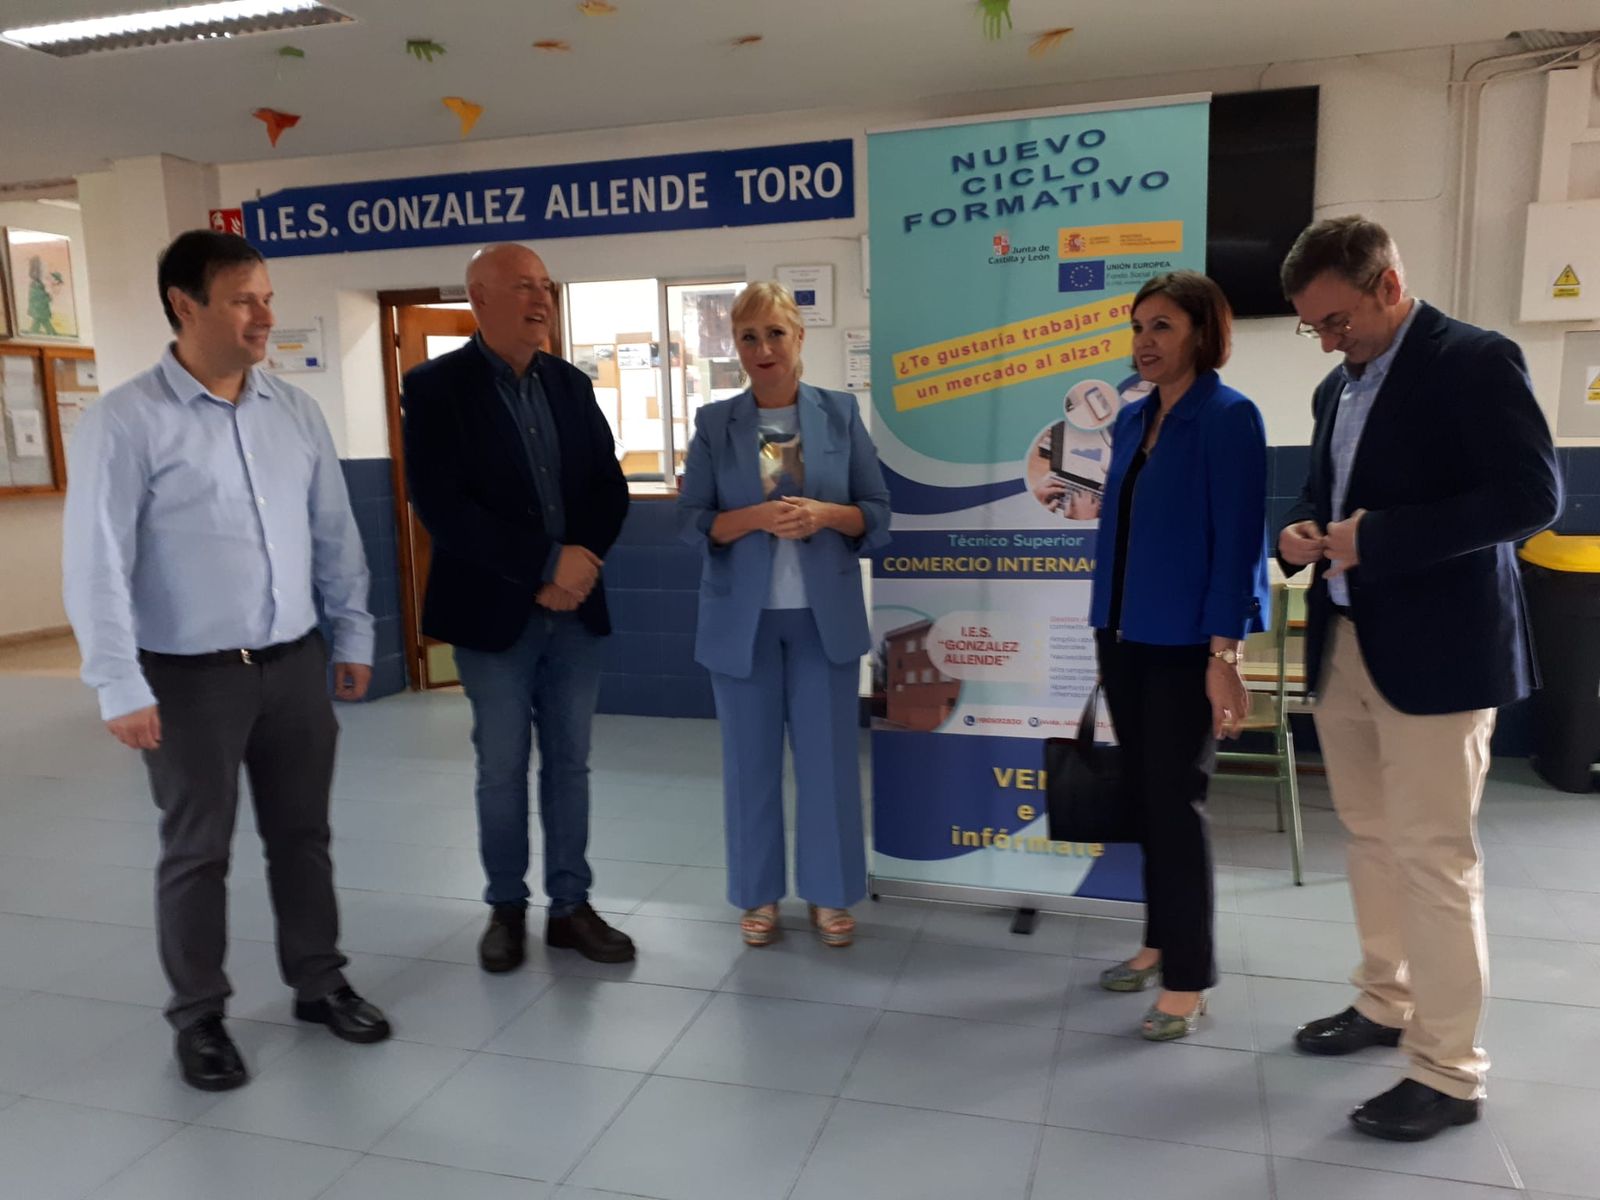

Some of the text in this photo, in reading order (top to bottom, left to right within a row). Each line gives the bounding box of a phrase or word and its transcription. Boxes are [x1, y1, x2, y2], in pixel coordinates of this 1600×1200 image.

[951, 128, 1107, 175] NUEVO
[961, 156, 1101, 196] CICLO
[256, 161, 844, 241] I.E.S. GONZALEZ ALLENDE TORO
[903, 170, 1171, 234] FORMATIVO
[1012, 244, 1050, 254] Junta de
[988, 255, 1018, 265] Castilla
[1028, 254, 1050, 262] León
[1106, 261, 1171, 271] UNIÓN EUROPEA
[899, 303, 1132, 376] ¿Te gustaría trabajar en
[916, 339, 1112, 400] un mercado al alza?
[949, 533, 1084, 549] Técnico Superior
[883, 556, 991, 572] COMERCIO
[961, 626, 991, 637] I.E.S.
[1017, 804, 1035, 820] e
